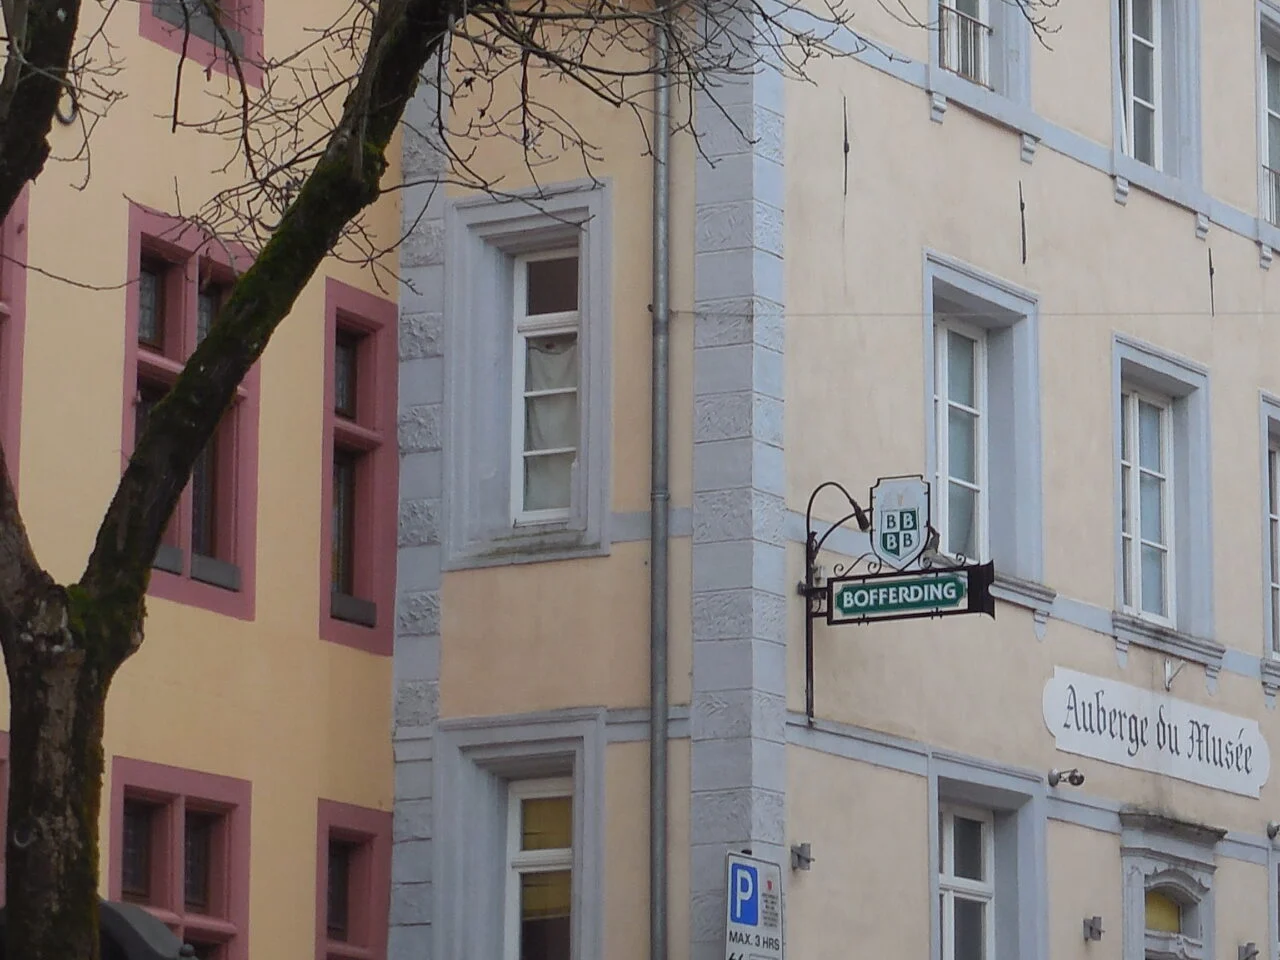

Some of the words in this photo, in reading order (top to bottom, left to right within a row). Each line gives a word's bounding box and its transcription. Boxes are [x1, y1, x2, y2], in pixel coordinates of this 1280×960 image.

[842, 582, 957, 608] BOFFERDING
[1063, 684, 1149, 757] Auberge
[1156, 704, 1181, 756] du
[1187, 719, 1253, 775] Musée
[736, 868, 753, 918] P
[728, 930, 753, 946] MAX.
[754, 934, 761, 948] 3
[762, 936, 780, 951] HRS
